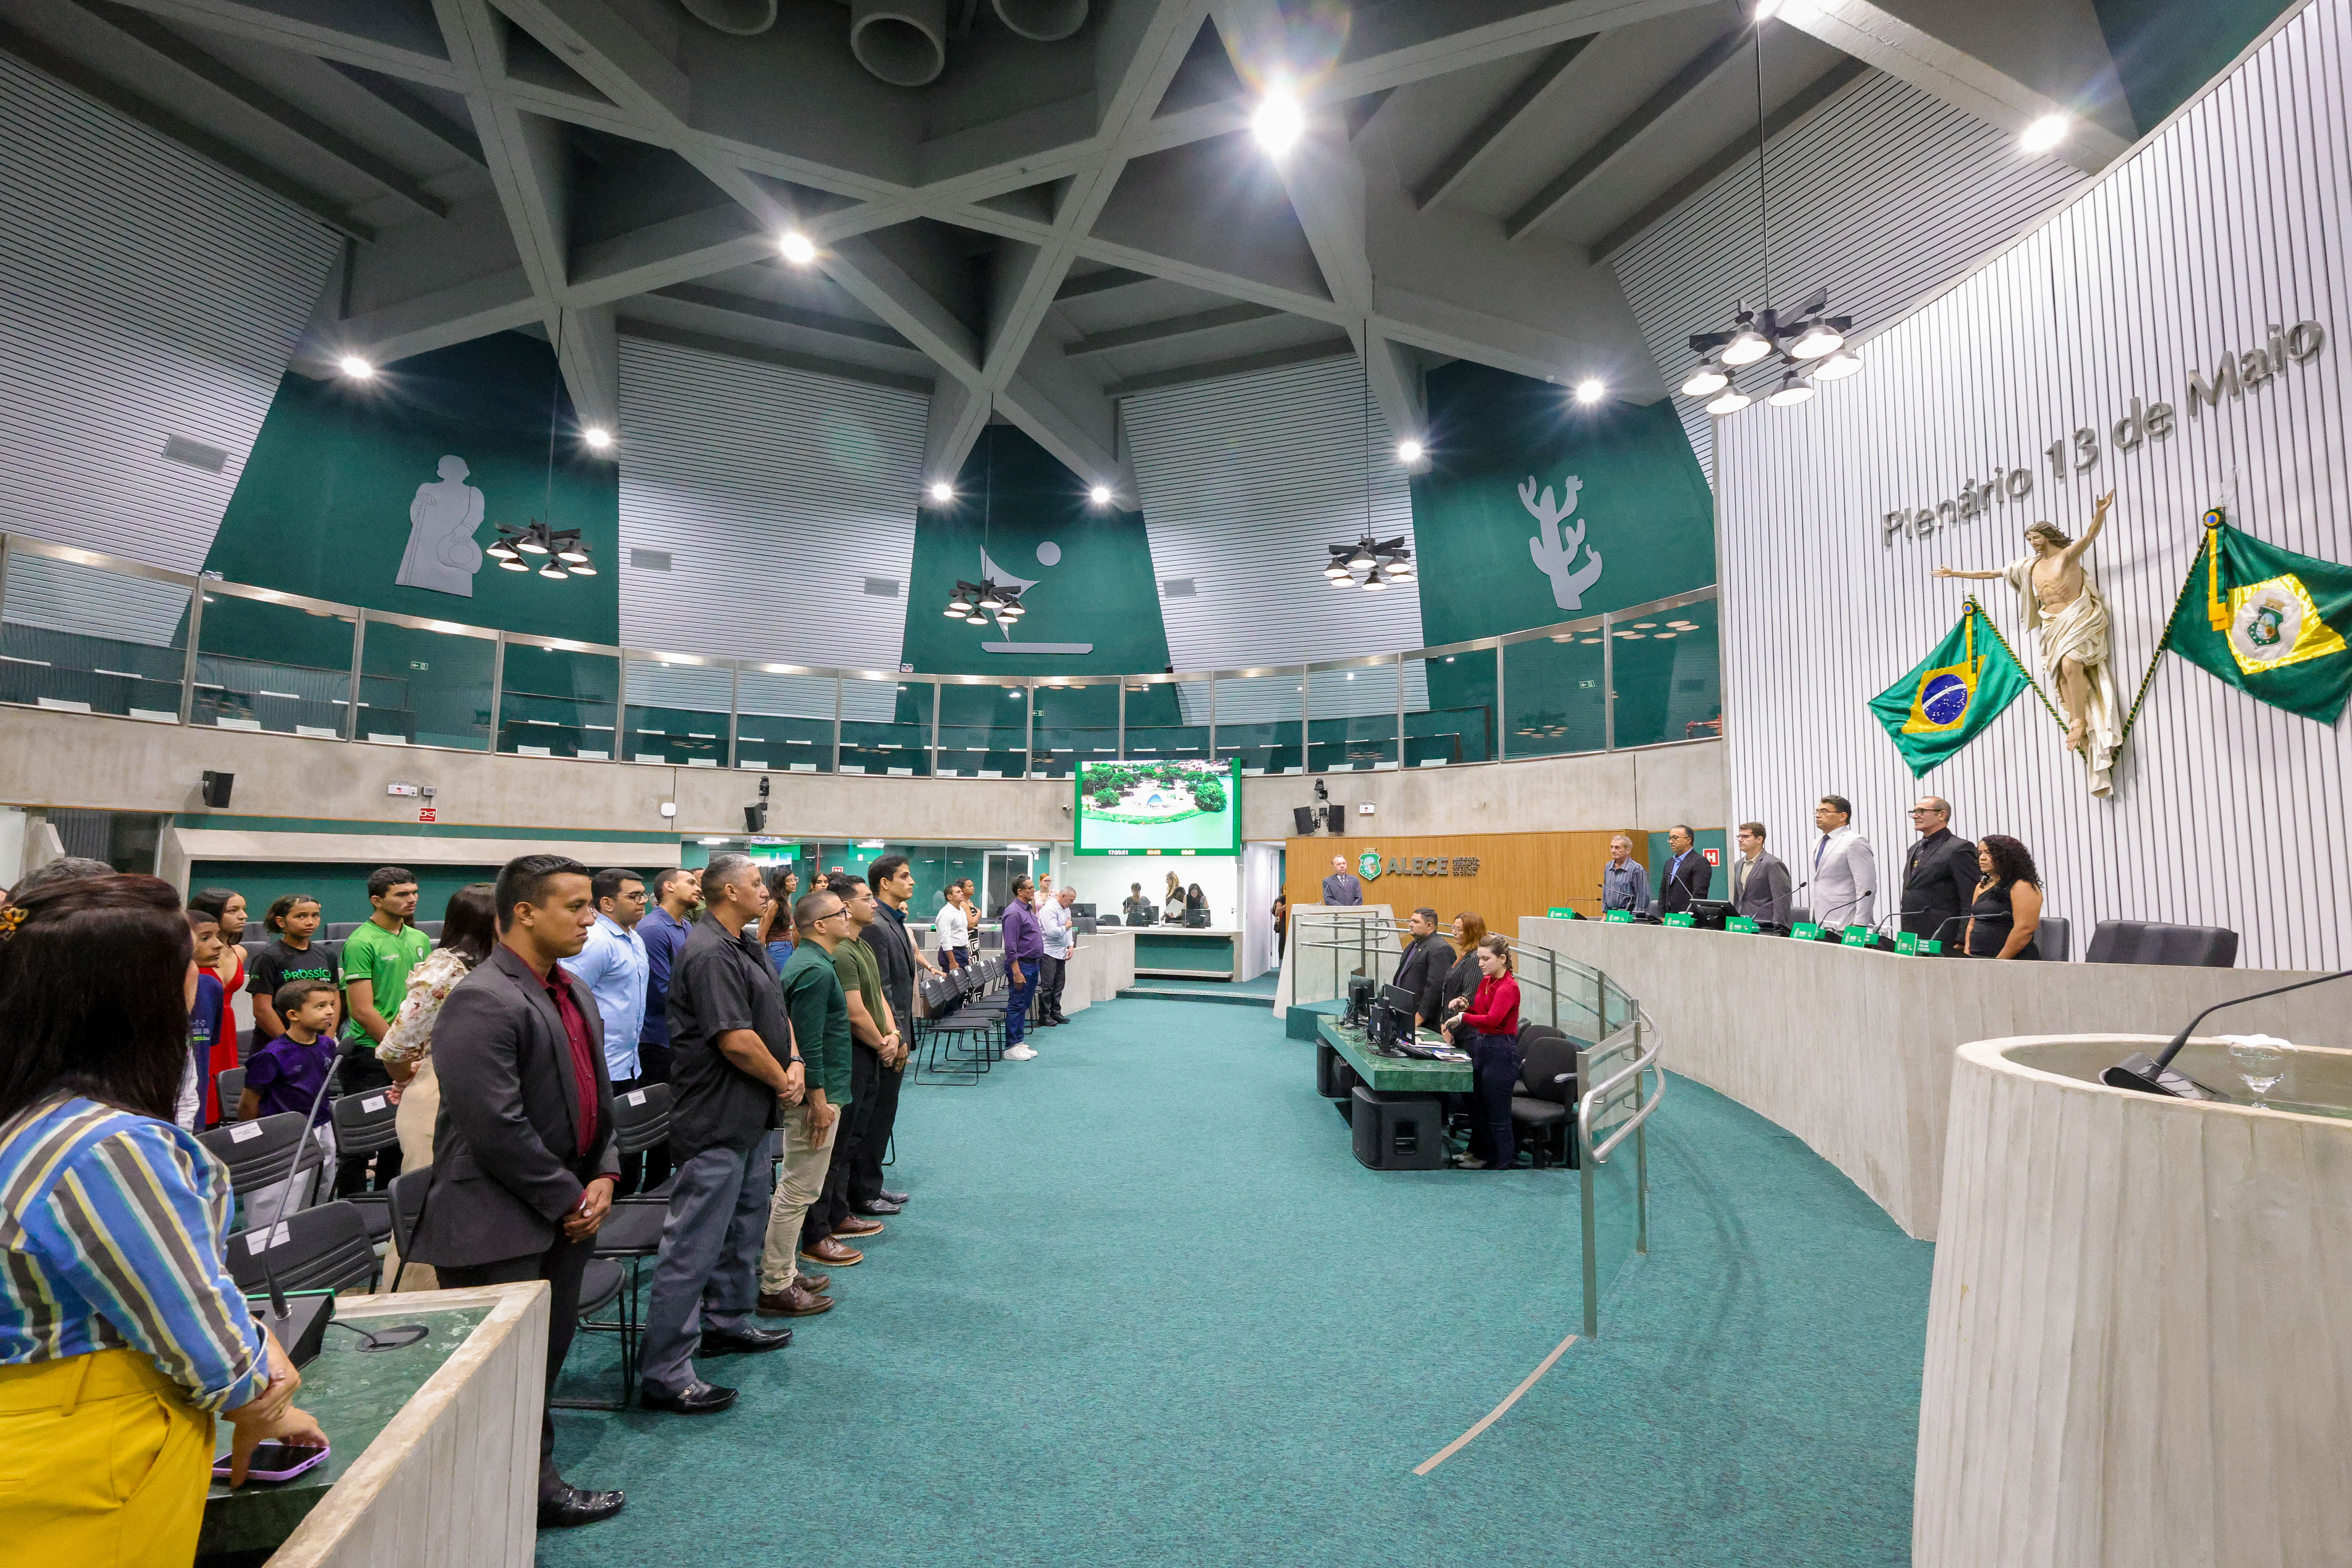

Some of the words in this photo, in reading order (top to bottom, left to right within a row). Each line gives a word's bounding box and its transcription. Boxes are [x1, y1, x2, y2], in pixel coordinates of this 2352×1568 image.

[1883, 467, 2033, 546] Plenário
[2044, 427, 2099, 478] 13
[2113, 396, 2173, 450] de
[2187, 320, 2325, 417] Maio
[1386, 856, 1449, 875] ALECE
[1706, 852, 1716, 863] H
